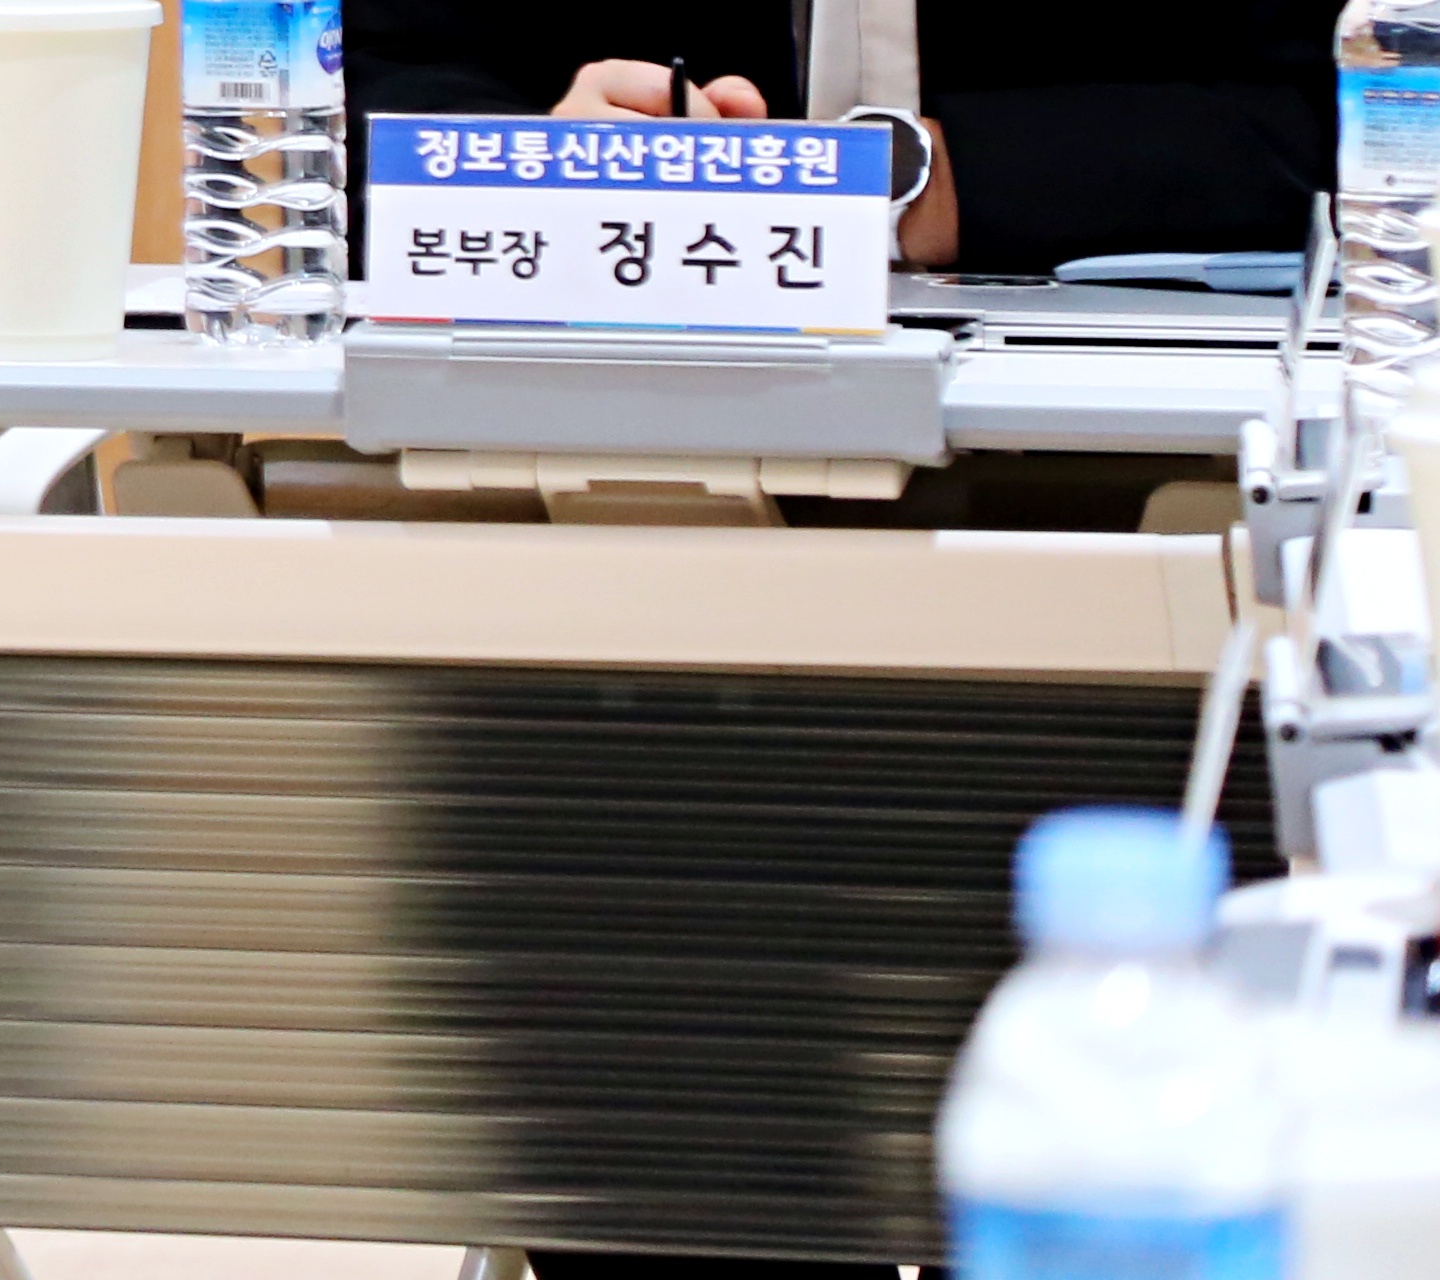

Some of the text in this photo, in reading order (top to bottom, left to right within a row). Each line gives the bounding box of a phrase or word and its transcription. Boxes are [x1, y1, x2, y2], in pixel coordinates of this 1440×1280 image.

[416, 128, 840, 187] 정보통신산업진흥원
[406, 220, 826, 290] 본부장 정수진
